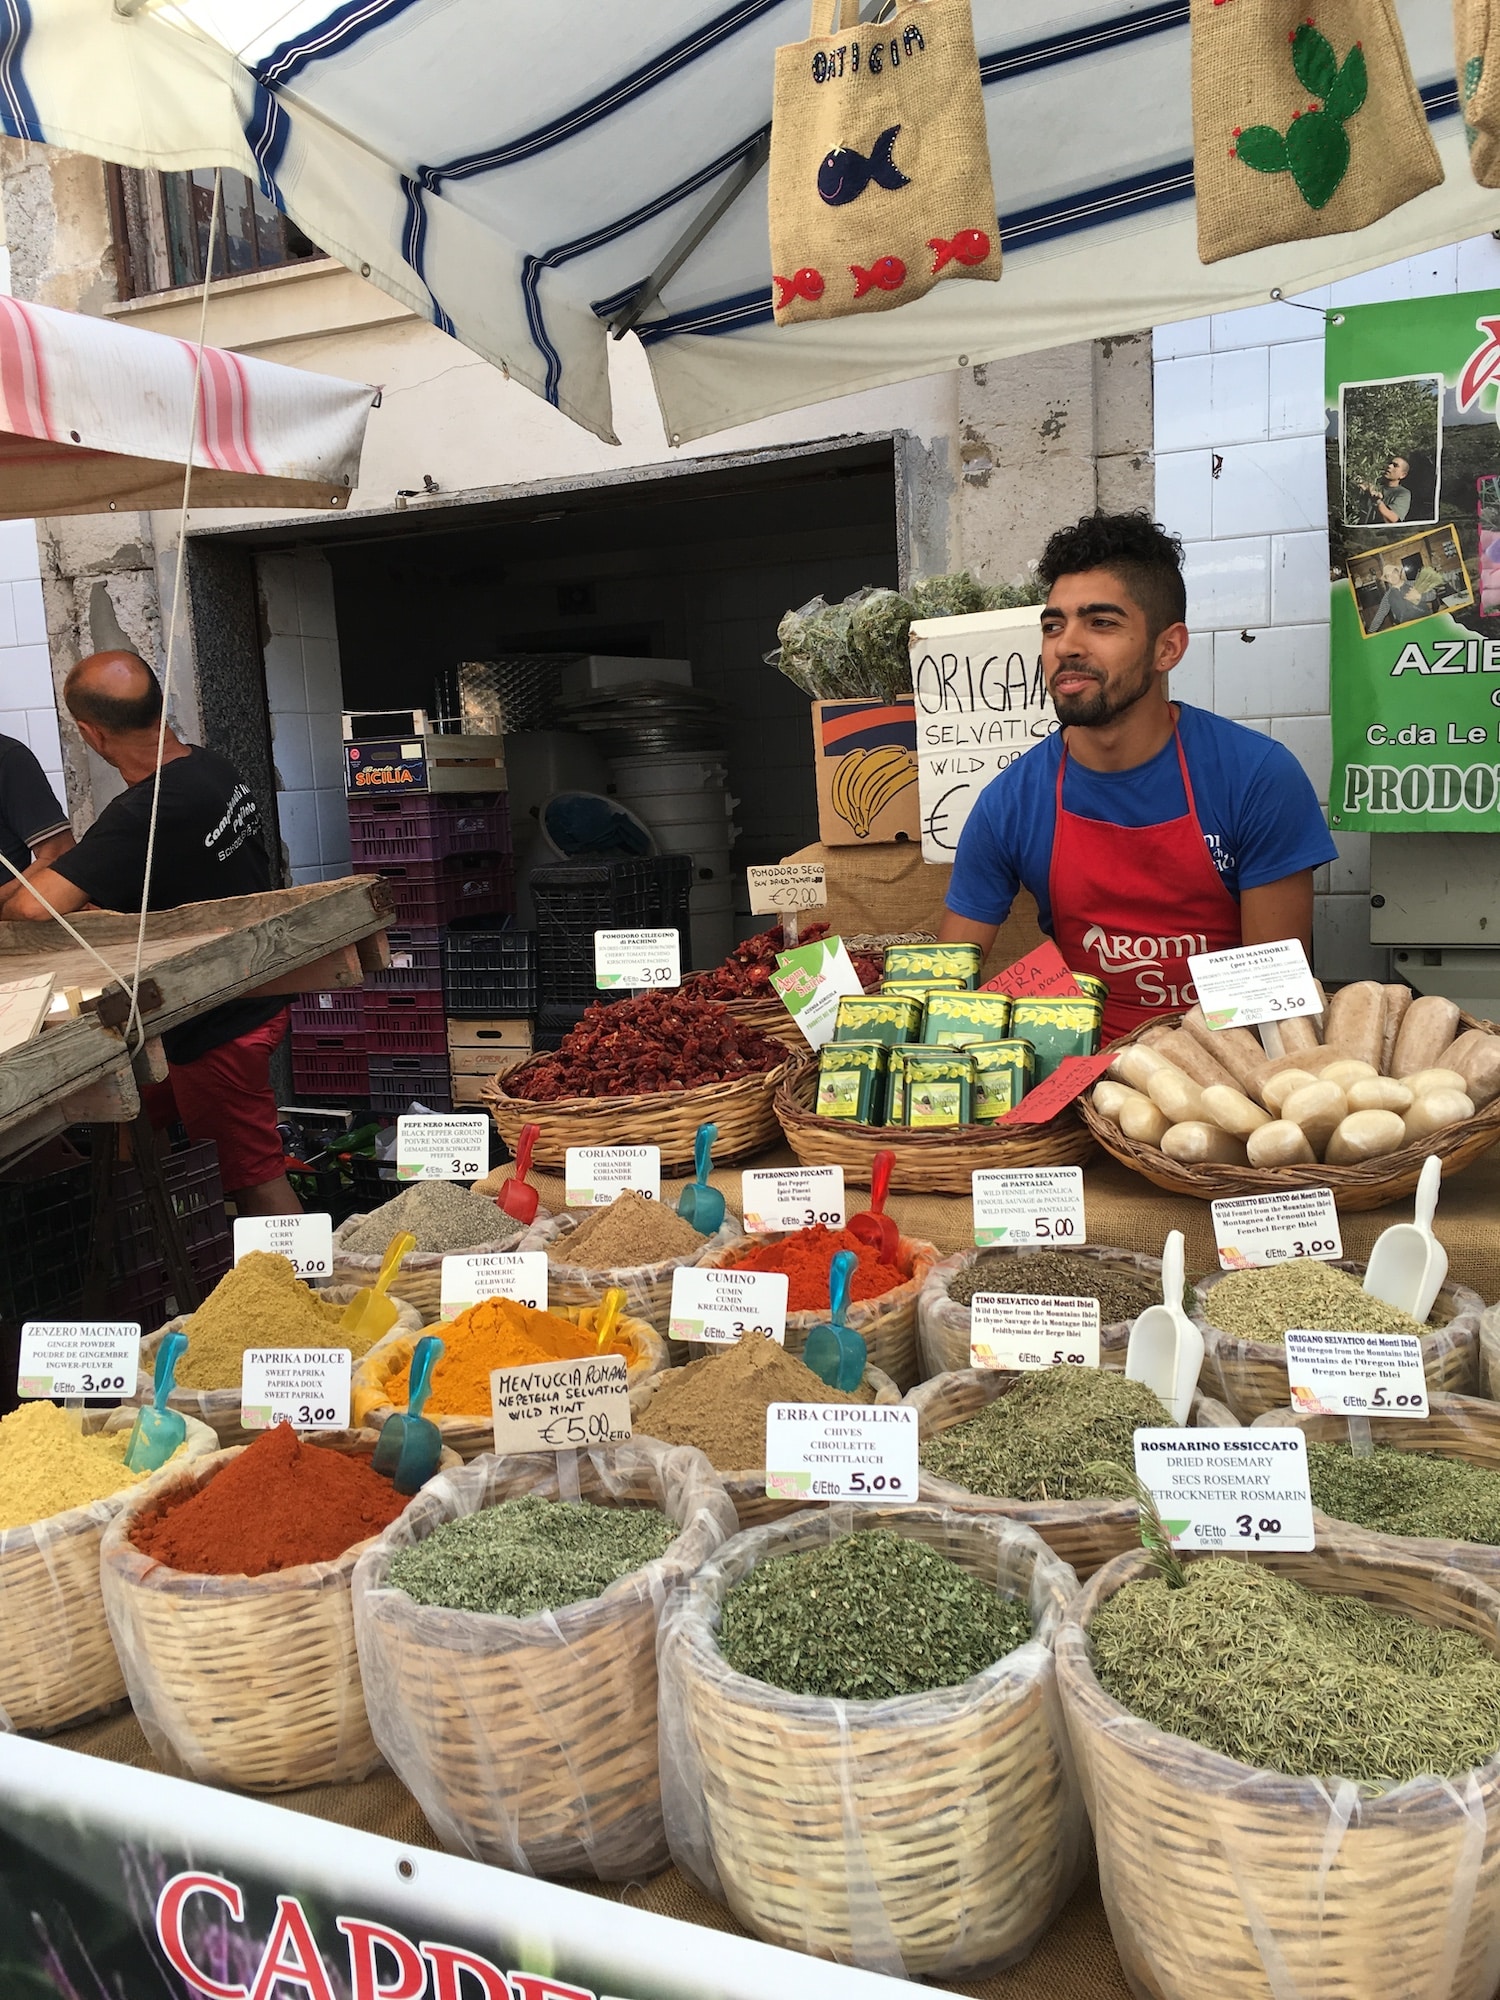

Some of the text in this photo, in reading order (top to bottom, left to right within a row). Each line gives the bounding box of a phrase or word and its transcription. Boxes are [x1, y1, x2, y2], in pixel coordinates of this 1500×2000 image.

[1390, 639, 1500, 676] AZIE
[917, 652, 1048, 714] ORIGAN
[1366, 723, 1487, 745] C.da Le
[930, 756, 984, 776] WILD
[355, 769, 413, 786] SICILIA
[1343, 763, 1500, 813] PRODO
[751, 865, 825, 877] POMODORO SECCO
[1209, 955, 1234, 964] PASTA
[1246, 945, 1290, 957] MANDORLE
[1002, 967, 1042, 995] TRA
[1269, 997, 1305, 1011] 3,50
[579, 1149, 647, 1158] CORIANDOLO
[452, 1160, 478, 1176] 3,00
[753, 1169, 833, 1180] PEPERONCINO PICCANTE
[977, 1173, 1033, 1181] FINOCCHIETTO
[1214, 1199, 1257, 1210] FINOCCHIETTO
[1259, 1195, 1290, 1204] SELVATICO
[1300, 1192, 1317, 1200] Monti
[265, 1218, 301, 1228] CURRY
[782, 1209, 840, 1225] €/Etto 3,00
[1223, 1218, 1263, 1227] Montagnes
[1277, 1212, 1305, 1220] Fenouil
[1009, 1217, 1074, 1241] €/Etto 5,00
[1238, 1220, 1317, 1235] Fenchel Berge Iblei
[1265, 1239, 1335, 1259] €/Etto 3,00
[467, 1256, 524, 1267] CURCUMA
[477, 1269, 515, 1277] TURMERIC
[706, 1272, 756, 1285] CUMINO
[477, 1287, 513, 1295] CURCUMA
[716, 1287, 743, 1295] CUMIN
[716, 1296, 742, 1304] CUMIN
[976, 1297, 995, 1305] TIMO
[997, 1298, 1040, 1306] SELVATICO
[698, 1303, 760, 1314] KREUZKÜMMEL
[993, 1308, 1013, 1316] thyme
[1046, 1310, 1080, 1318] Mountains
[28, 1327, 137, 1337] ZENZERO MACINATO
[704, 1327, 725, 1339] €/Etto
[992, 1327, 1031, 1336] Feldthymian
[1288, 1334, 1323, 1344] ORIGANO
[1325, 1336, 1365, 1345] SELVATICO
[1367, 1338, 1377, 1346] dei
[1401, 1339, 1417, 1347] Iblei
[1290, 1345, 1306, 1353] Wild
[1308, 1346, 1333, 1355] Oregon
[1335, 1347, 1352, 1355] from
[1354, 1348, 1365, 1356] the
[1367, 1348, 1402, 1357] Mountains
[251, 1353, 345, 1364] PAPRIKA DOLCE
[1292, 1355, 1339, 1365] Mountains
[1398, 1360, 1419, 1368] Iblei
[499, 1362, 627, 1394] MENTUCCIA ROMANA
[1312, 1367, 1346, 1376] Oregon
[1349, 1369, 1377, 1378] berge
[54, 1374, 124, 1393] €/Etto 3,00
[499, 1384, 629, 1407] NEPETELLA SELVATICA
[1343, 1396, 1367, 1407] €/Etto
[298, 1406, 335, 1424] 3,00
[509, 1401, 586, 1421] WILD MINT
[777, 1408, 911, 1423] ERBA CIPOLLINA
[824, 1428, 862, 1437] CHIVES
[810, 1441, 876, 1450] CIBOULETTE
[1141, 1442, 1298, 1451] ROSMARINO ESSICCATO
[802, 1454, 883, 1464] SCHNITTLAUCH
[1167, 1457, 1273, 1467] DRIED ROSEMARY
[812, 1473, 901, 1495] €/Etto 5,00
[1172, 1475, 1271, 1485] SECS ROSEMARY
[1150, 1490, 1306, 1500] ETROCKNETER ROSMARIN
[1194, 1514, 1281, 1541] €/Etto 3,00
